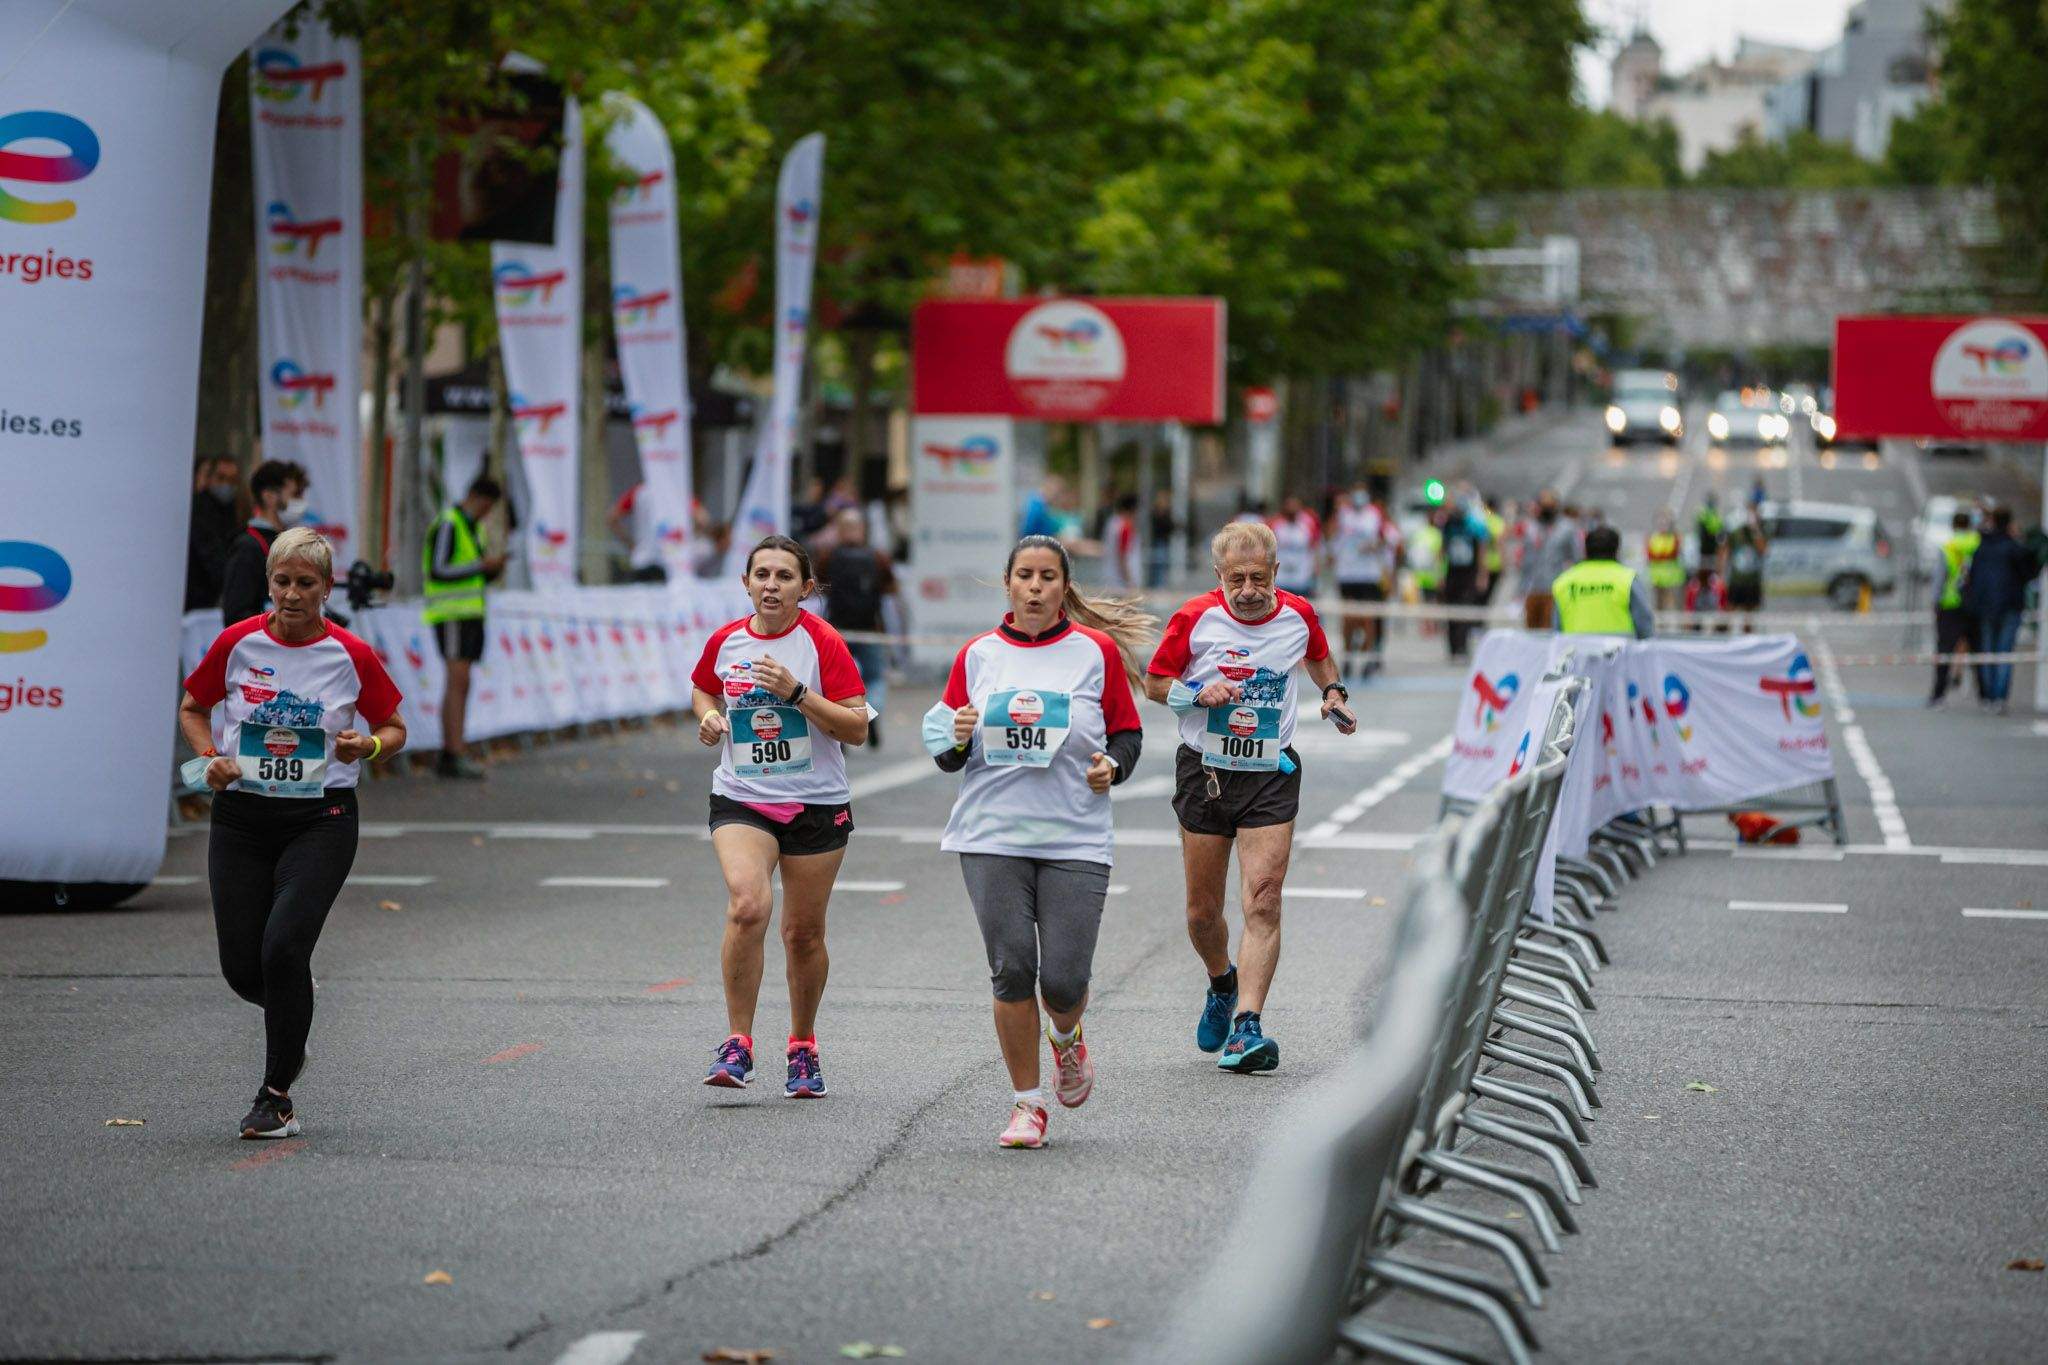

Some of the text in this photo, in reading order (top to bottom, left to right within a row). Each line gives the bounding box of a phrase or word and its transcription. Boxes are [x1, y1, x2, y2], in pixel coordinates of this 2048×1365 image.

[0, 247, 92, 282] rgies
[1, 408, 82, 438] ies.es
[1006, 727, 1047, 750] 594
[1220, 736, 1264, 759] 1001
[752, 740, 791, 764] 590
[258, 758, 303, 782] 589
